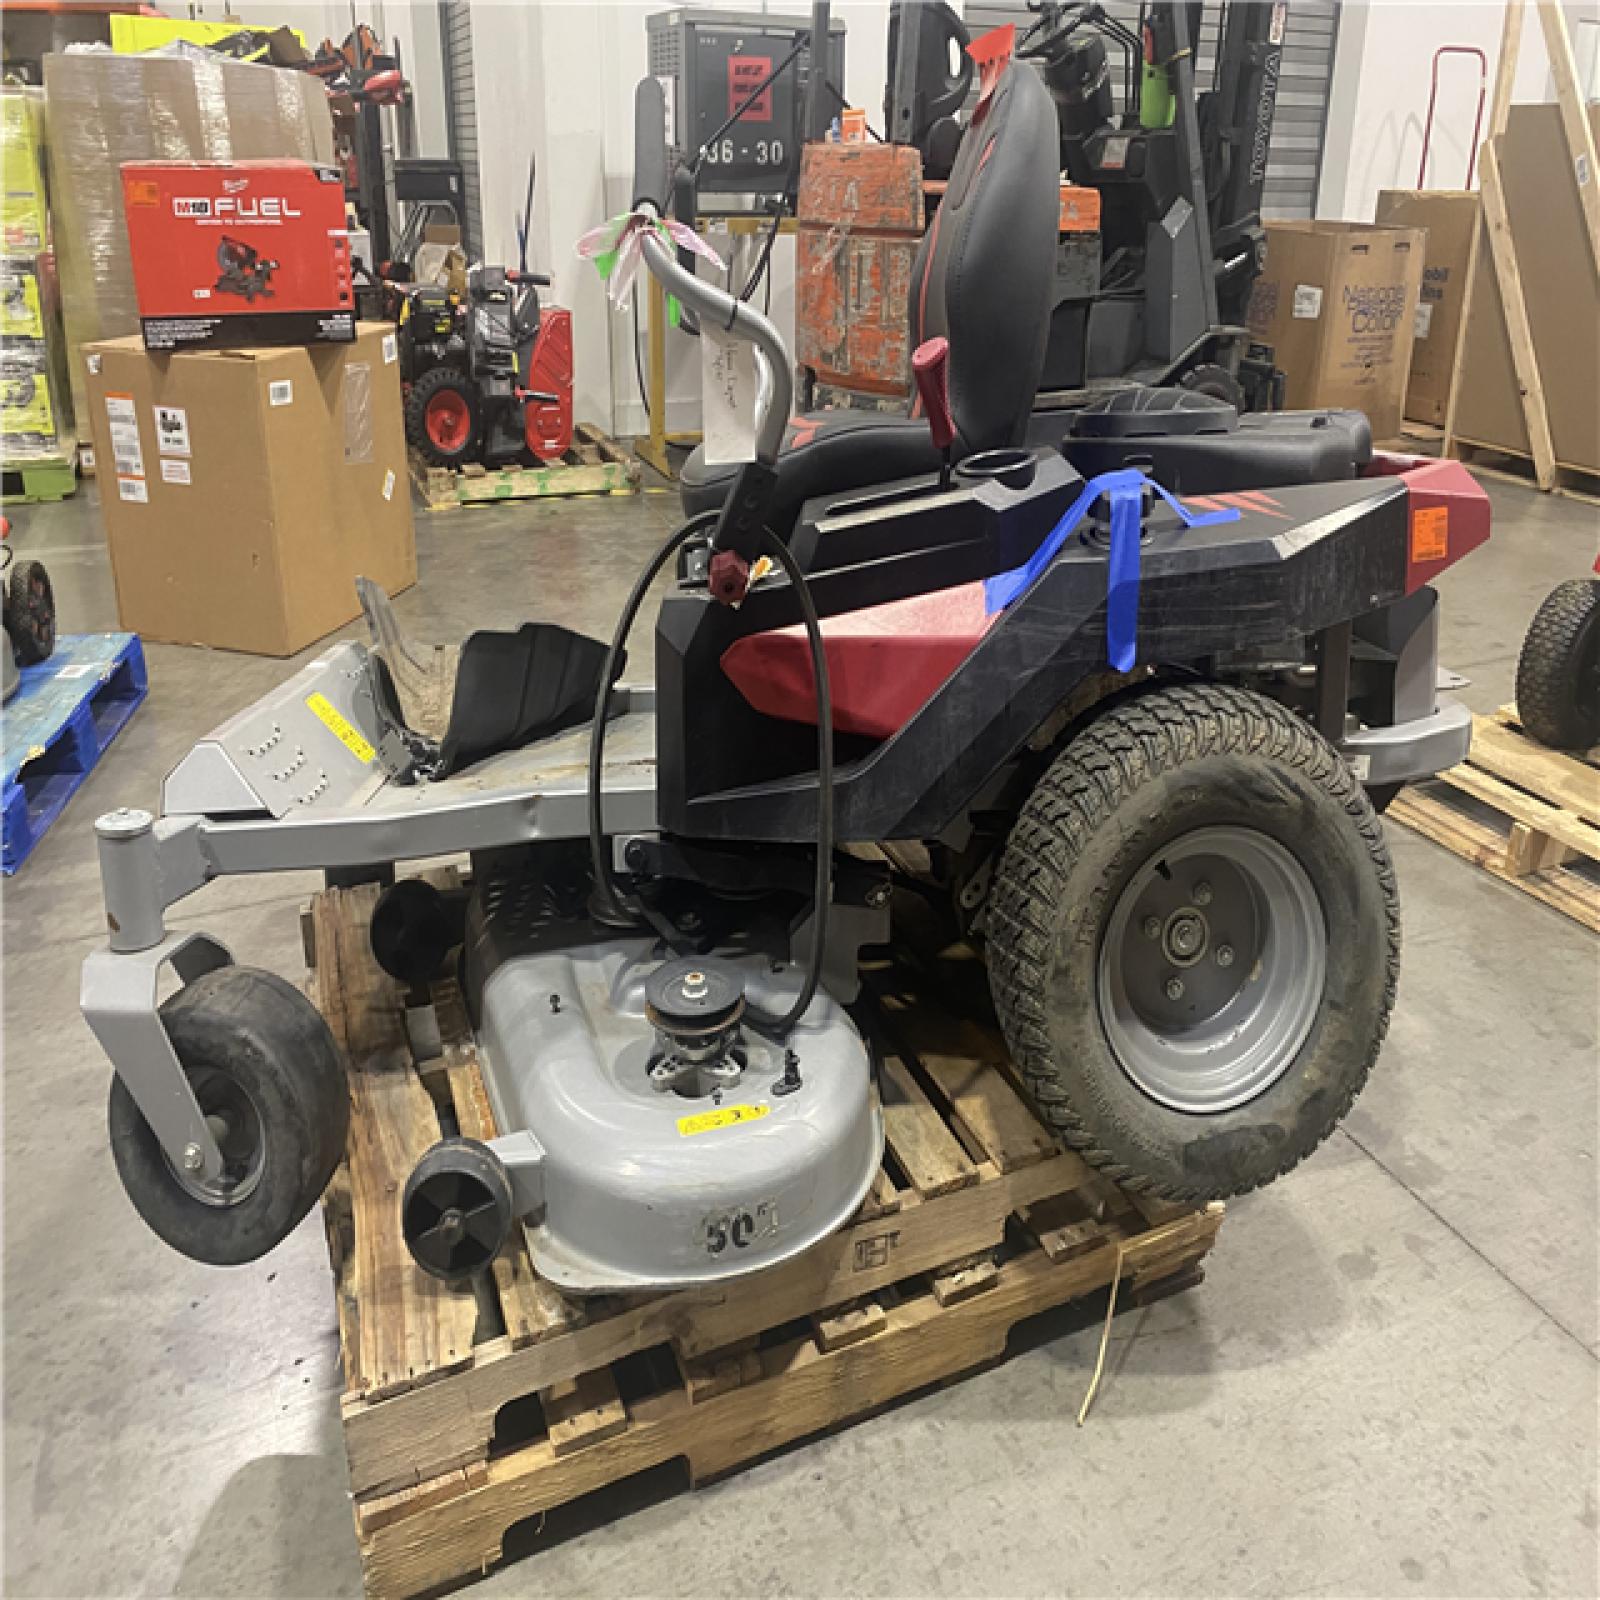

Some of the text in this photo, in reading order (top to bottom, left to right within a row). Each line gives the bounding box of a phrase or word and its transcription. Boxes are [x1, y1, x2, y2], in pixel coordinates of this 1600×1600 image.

[1249, 52, 1280, 186] TOYOTA
[756, 140, 784, 166] 30
[214, 197, 301, 216] FUEL
